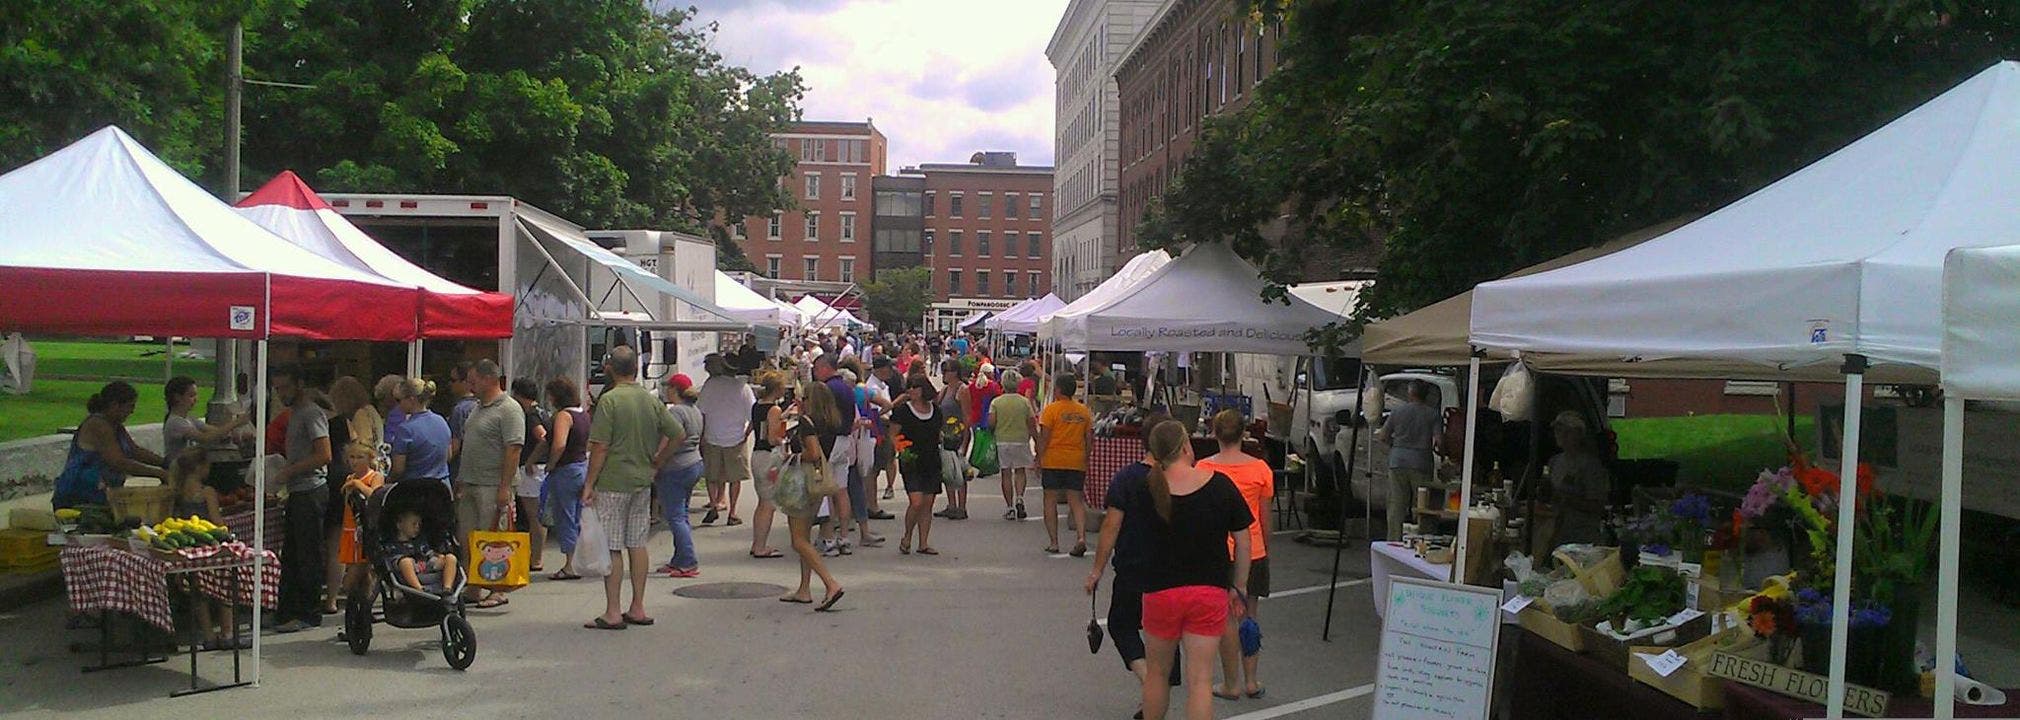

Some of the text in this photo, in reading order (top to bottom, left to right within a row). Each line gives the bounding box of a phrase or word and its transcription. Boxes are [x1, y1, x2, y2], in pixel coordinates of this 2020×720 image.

[1111, 326, 1156, 340] Locally
[1158, 326, 1215, 338] Roasted
[1218, 327, 1243, 338] and
[1712, 654, 1777, 687] FRESH
[1785, 672, 1886, 714] FLOERS
